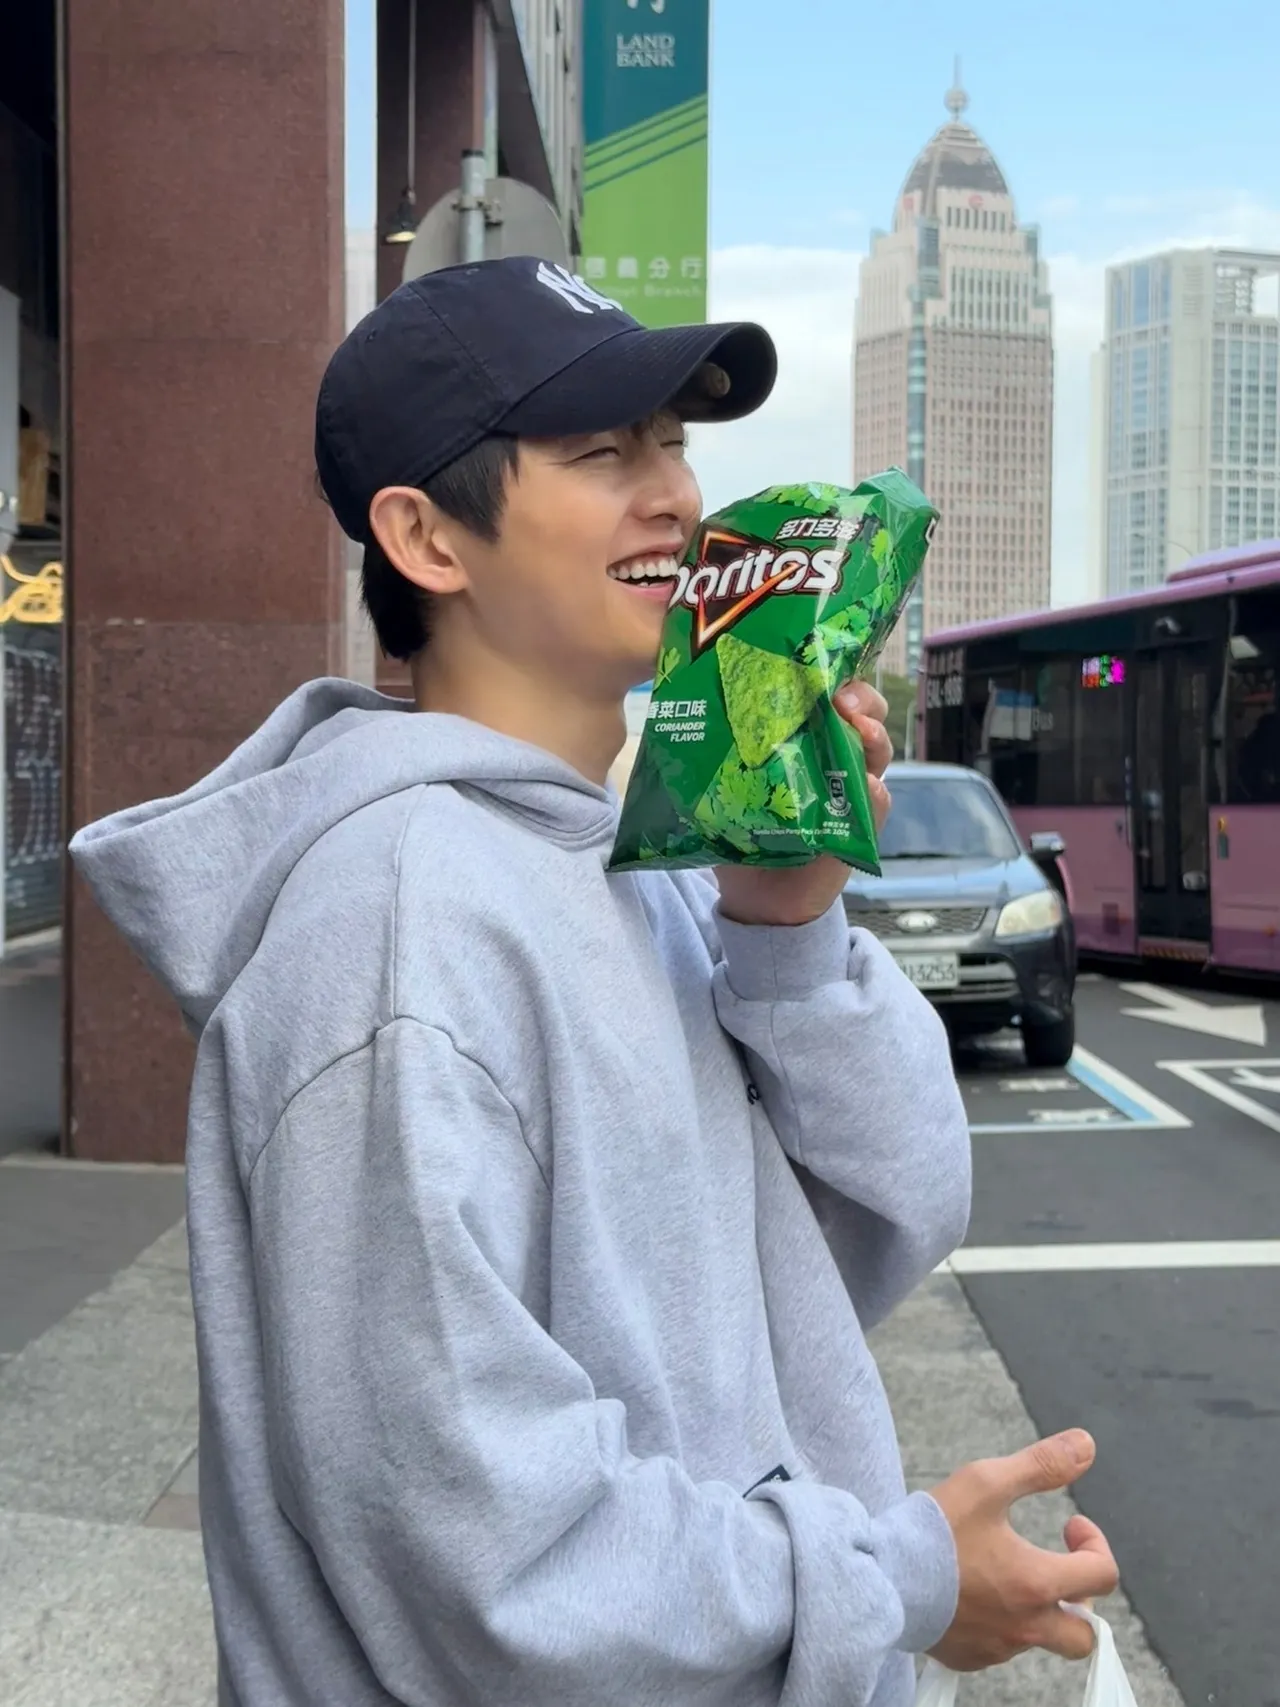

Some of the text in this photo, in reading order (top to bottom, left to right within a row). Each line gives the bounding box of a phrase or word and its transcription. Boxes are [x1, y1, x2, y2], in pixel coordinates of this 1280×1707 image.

[616, 33, 675, 50] LAND
[616, 50, 675, 67] BANK
[775, 517, 860, 540] 多力多滋
[654, 722, 705, 732] CORIANDER
[670, 732, 705, 742] FLAVOR
